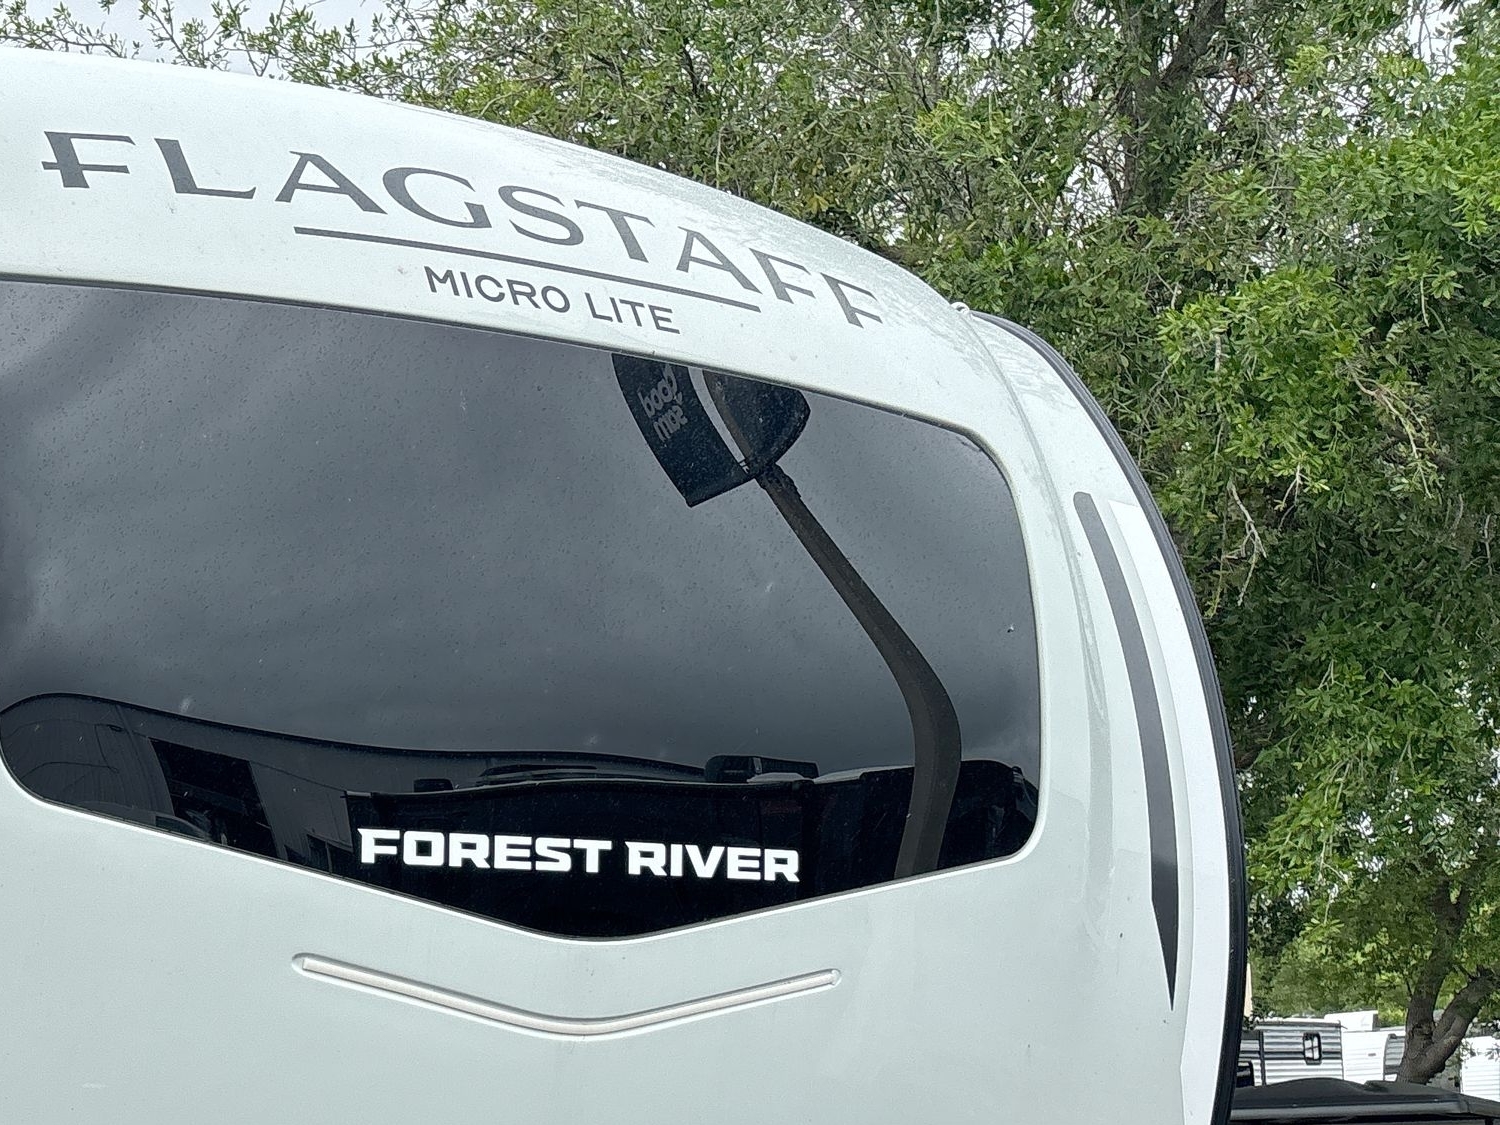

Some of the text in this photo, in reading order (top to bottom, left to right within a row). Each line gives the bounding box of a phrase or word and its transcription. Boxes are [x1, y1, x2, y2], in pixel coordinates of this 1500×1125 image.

[42, 130, 884, 329] FLAGSTAFF
[425, 266, 681, 335] MICRO LITE
[357, 828, 800, 882] FOREST RIVER
